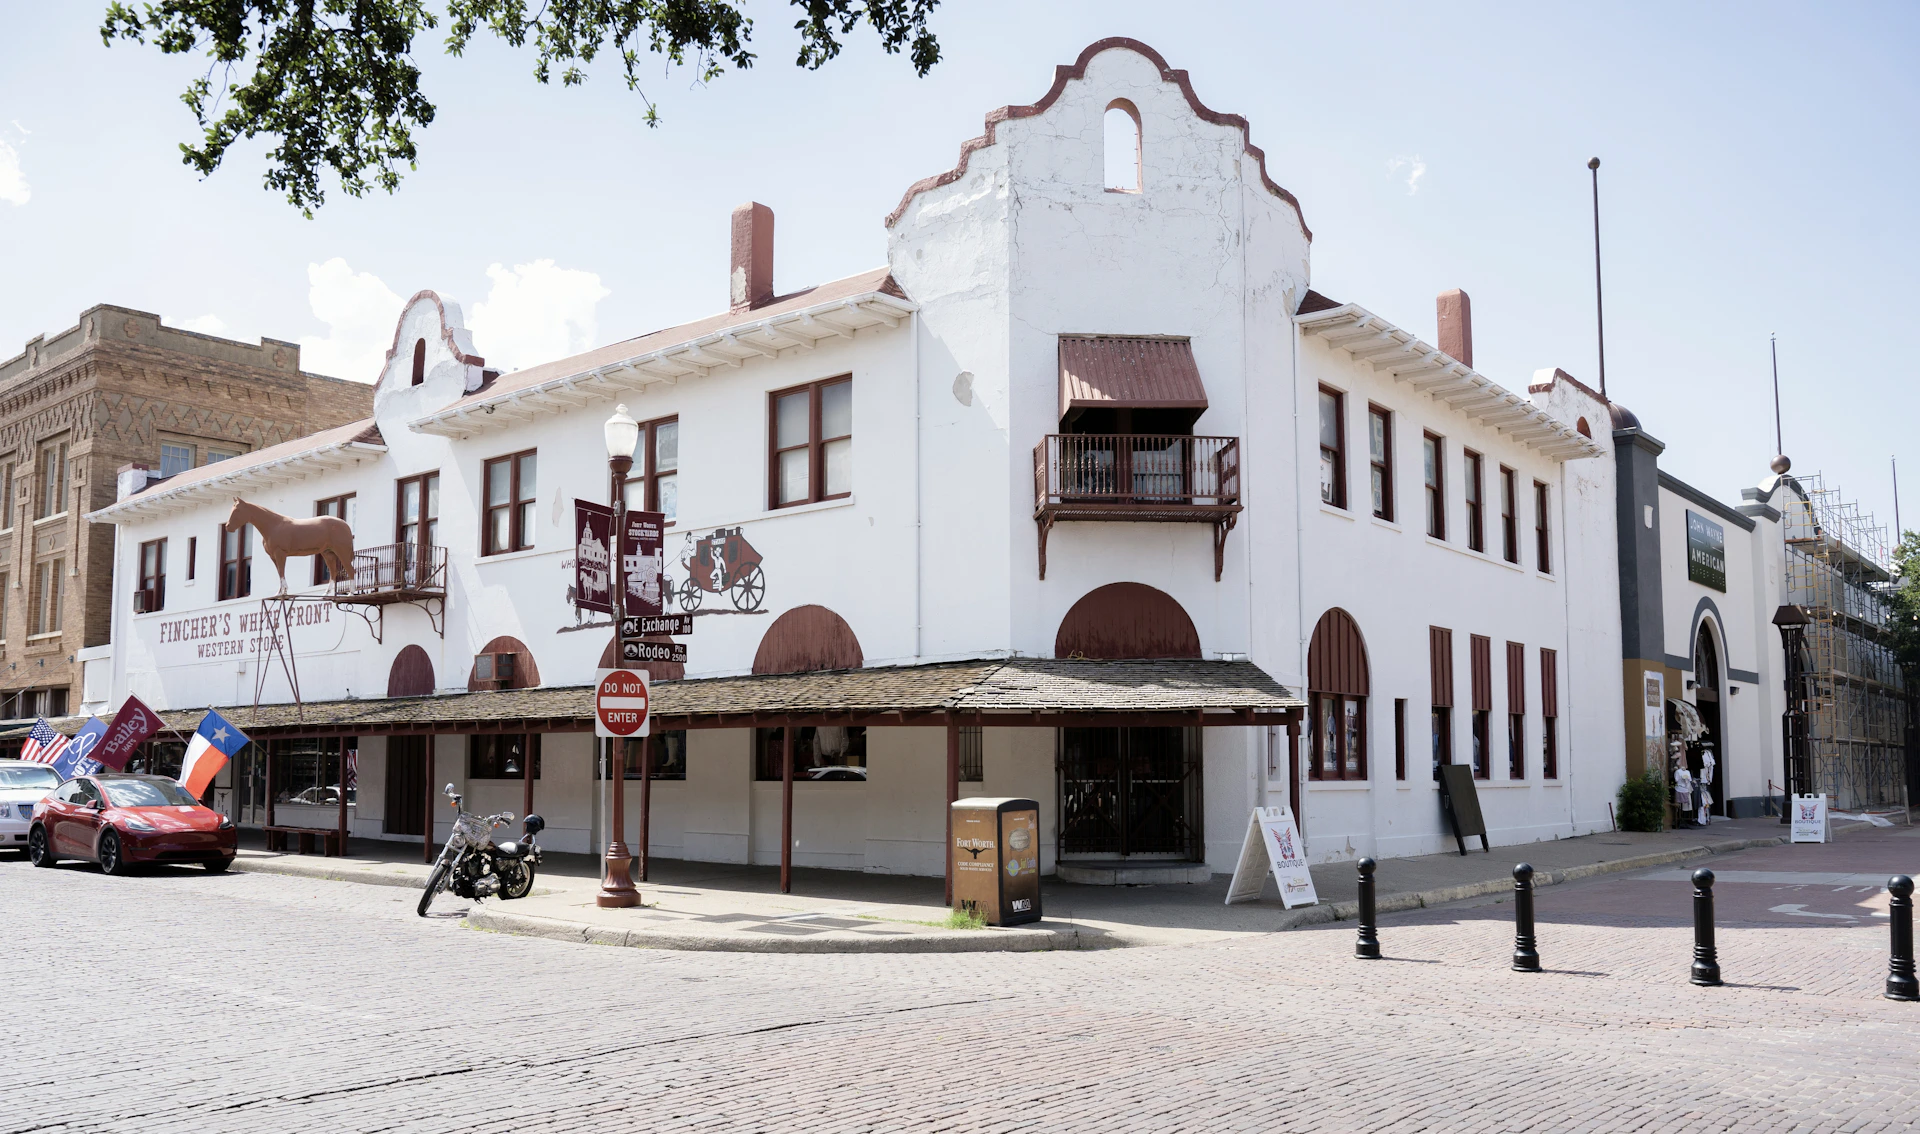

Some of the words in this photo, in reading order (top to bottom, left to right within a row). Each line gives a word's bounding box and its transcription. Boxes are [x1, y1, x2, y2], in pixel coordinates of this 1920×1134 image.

[1690, 518, 1704, 535] JOHN
[1705, 525, 1723, 544] WAYNE
[1691, 547, 1725, 574] AMERICAN
[160, 612, 231, 644] FINCHER'S
[239, 609, 280, 633] WHITE
[288, 602, 333, 628] FRONT
[633, 618, 639, 633] E
[641, 617, 680, 636] Exchange
[683, 615, 691, 624] Av
[682, 625, 691, 634] 100
[197, 639, 244, 658] WESTERN
[249, 634, 284, 653] STORE
[638, 643, 671, 660] Rodeo
[672, 654, 687, 662] 2500
[604, 682, 618, 693] DO
[622, 683, 641, 694] NOT
[608, 712, 637, 723] ENTER
[102, 707, 148, 755] Bailey
[121, 738, 136, 753] HATS
[957, 838, 971, 847] FORT
[1277, 859, 1304, 868] BOUTIQUE
